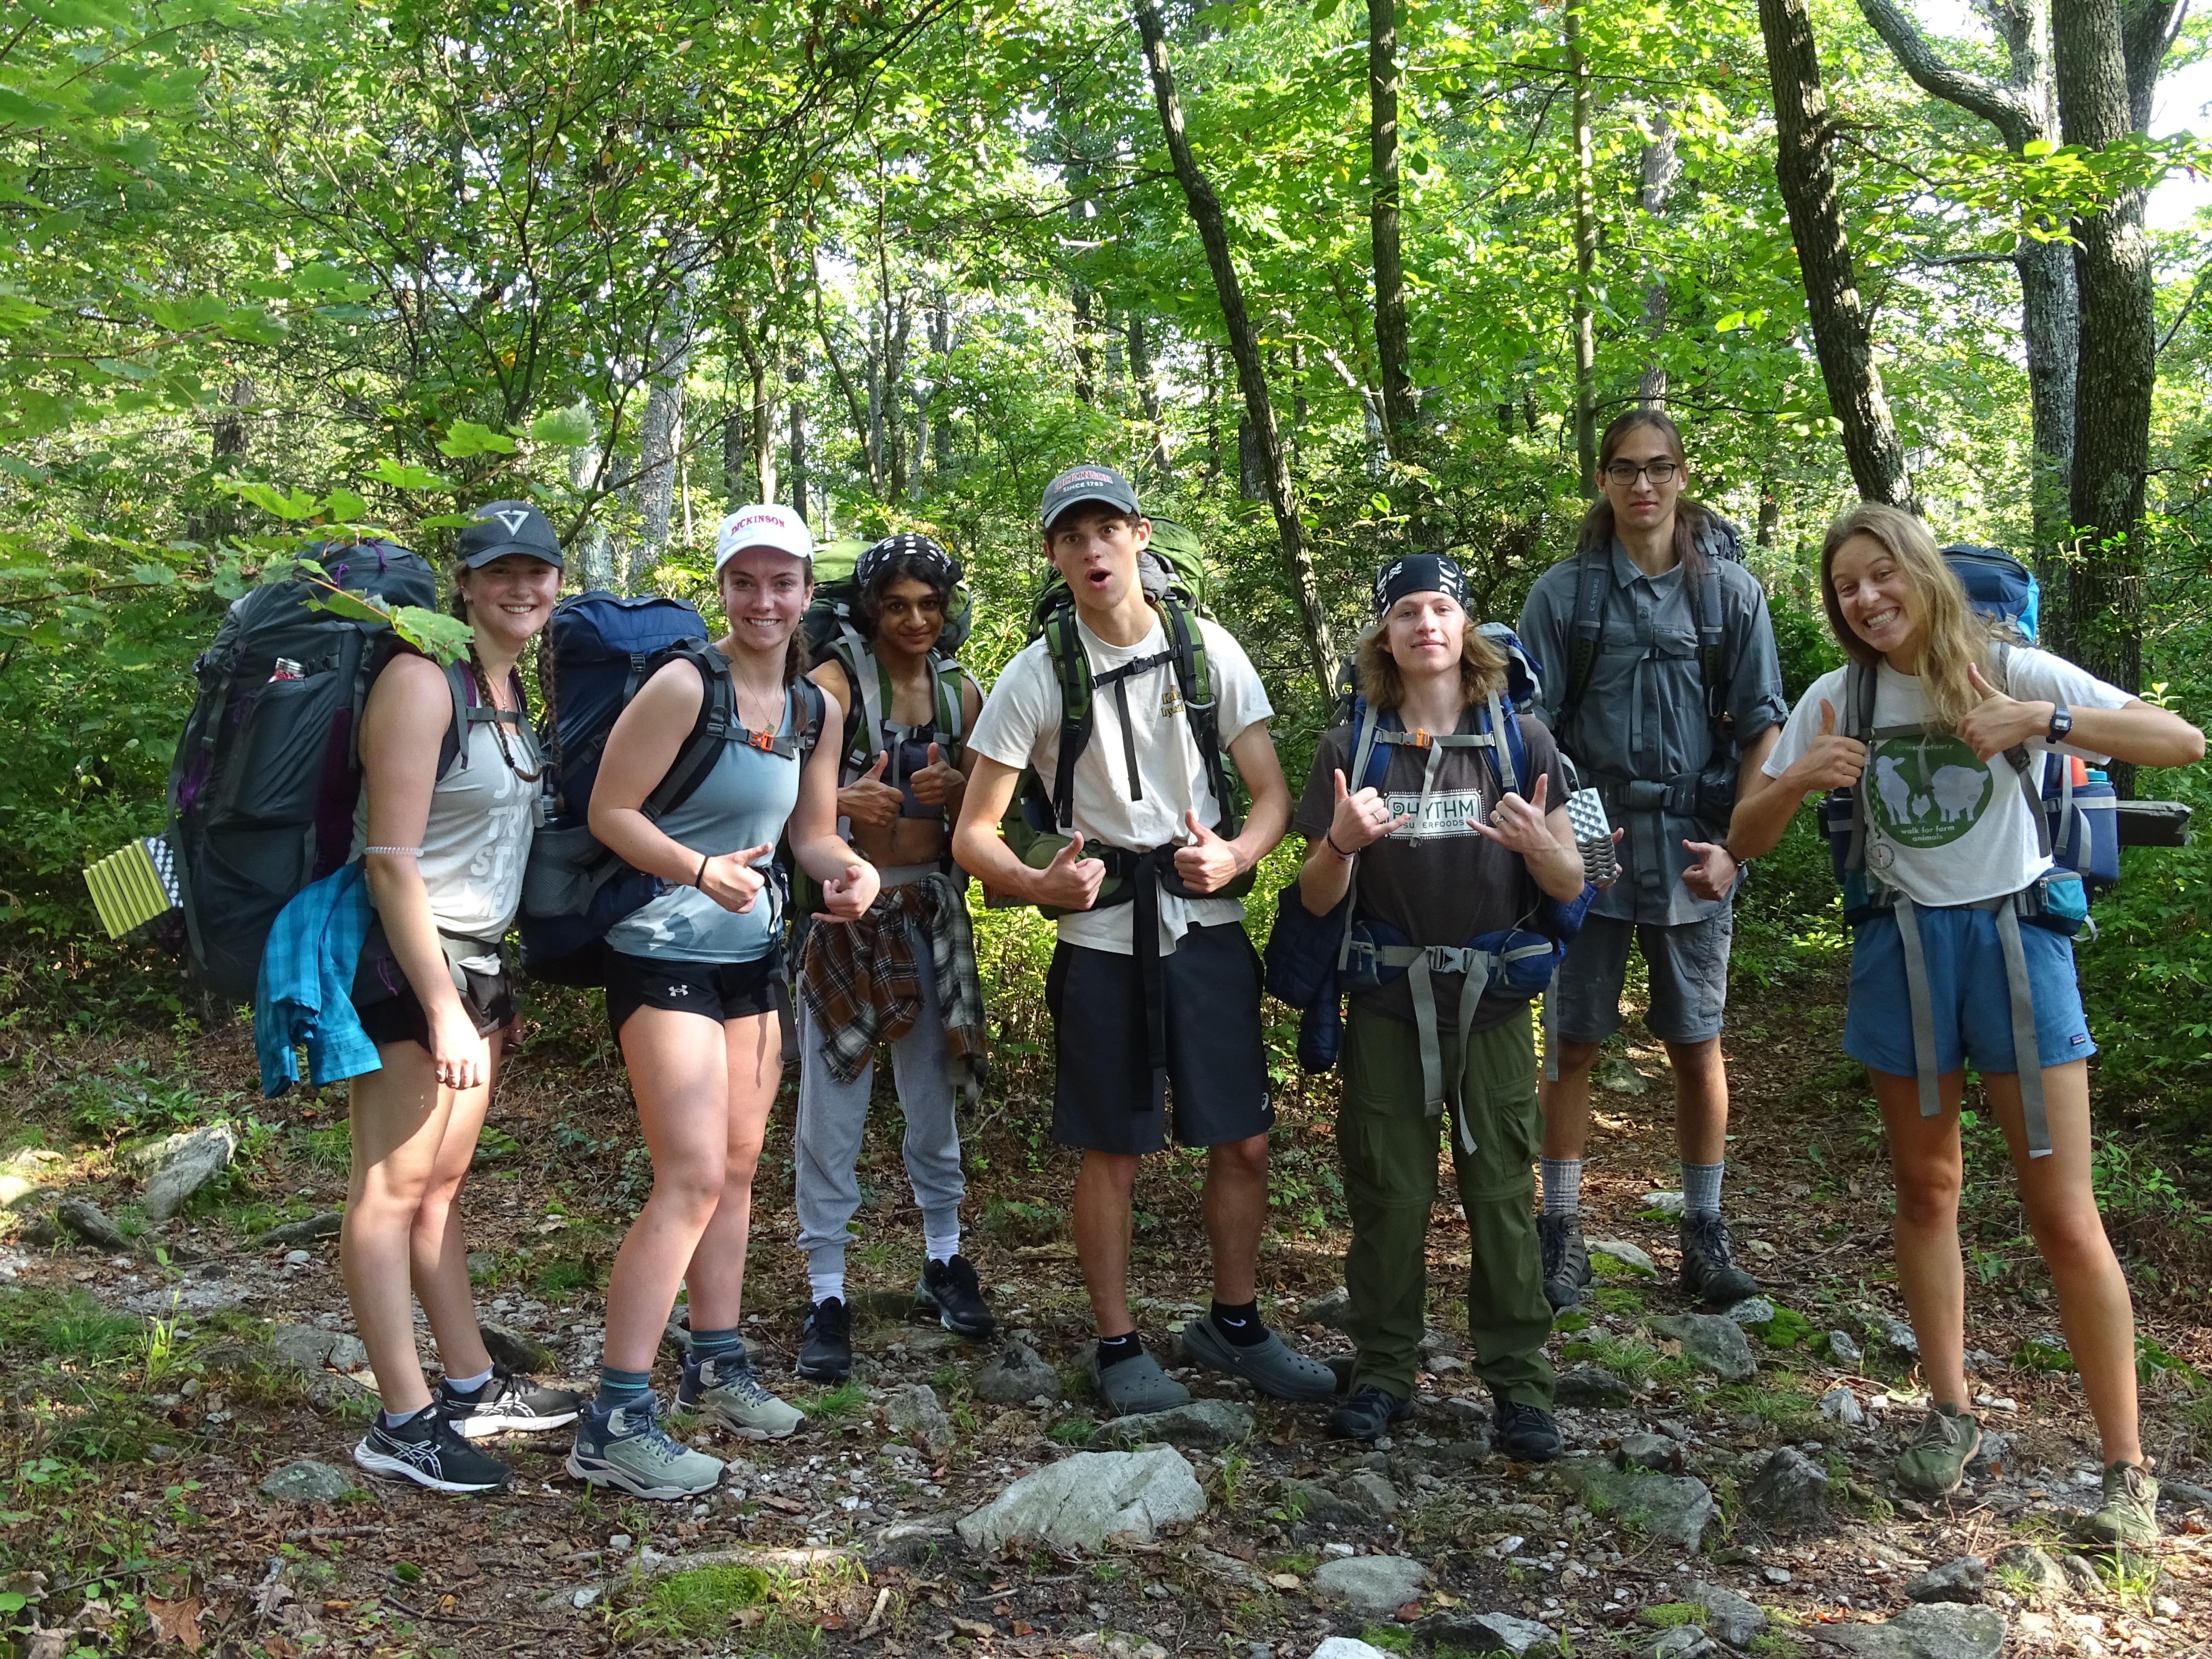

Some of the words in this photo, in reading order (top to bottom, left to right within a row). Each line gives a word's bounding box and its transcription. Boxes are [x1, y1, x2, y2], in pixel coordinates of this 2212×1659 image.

[1054, 470, 1113, 493] DICKINSON
[1063, 482, 1085, 492] SINCE
[730, 515, 785, 537] DICKINSON
[1393, 799, 1474, 820] RHYTHM
[1403, 819, 1464, 829] SUERFOODS
[1912, 833, 1943, 841] animals
